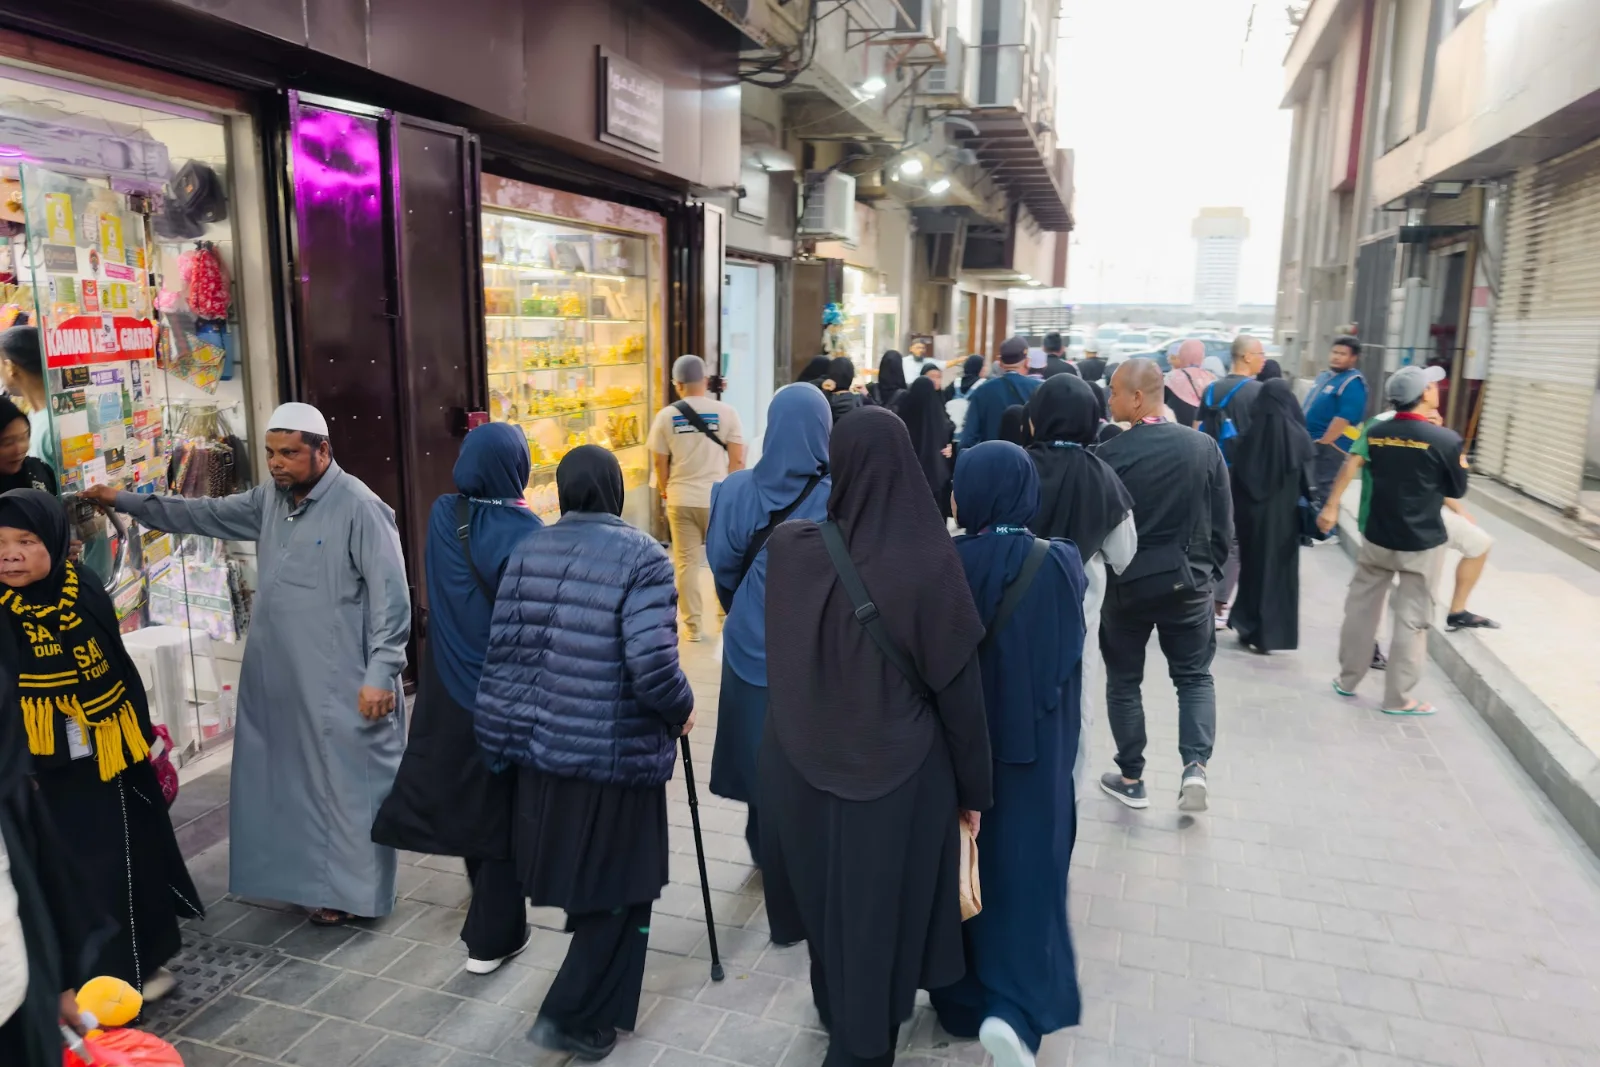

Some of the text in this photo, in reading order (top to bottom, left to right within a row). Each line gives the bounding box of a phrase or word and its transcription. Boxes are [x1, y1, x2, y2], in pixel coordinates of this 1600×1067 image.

[46, 328, 90, 357] KAMAR
[121, 327, 153, 350] GRATIS
[34, 644, 63, 657] OUR
[82, 659, 110, 681] TOUR
